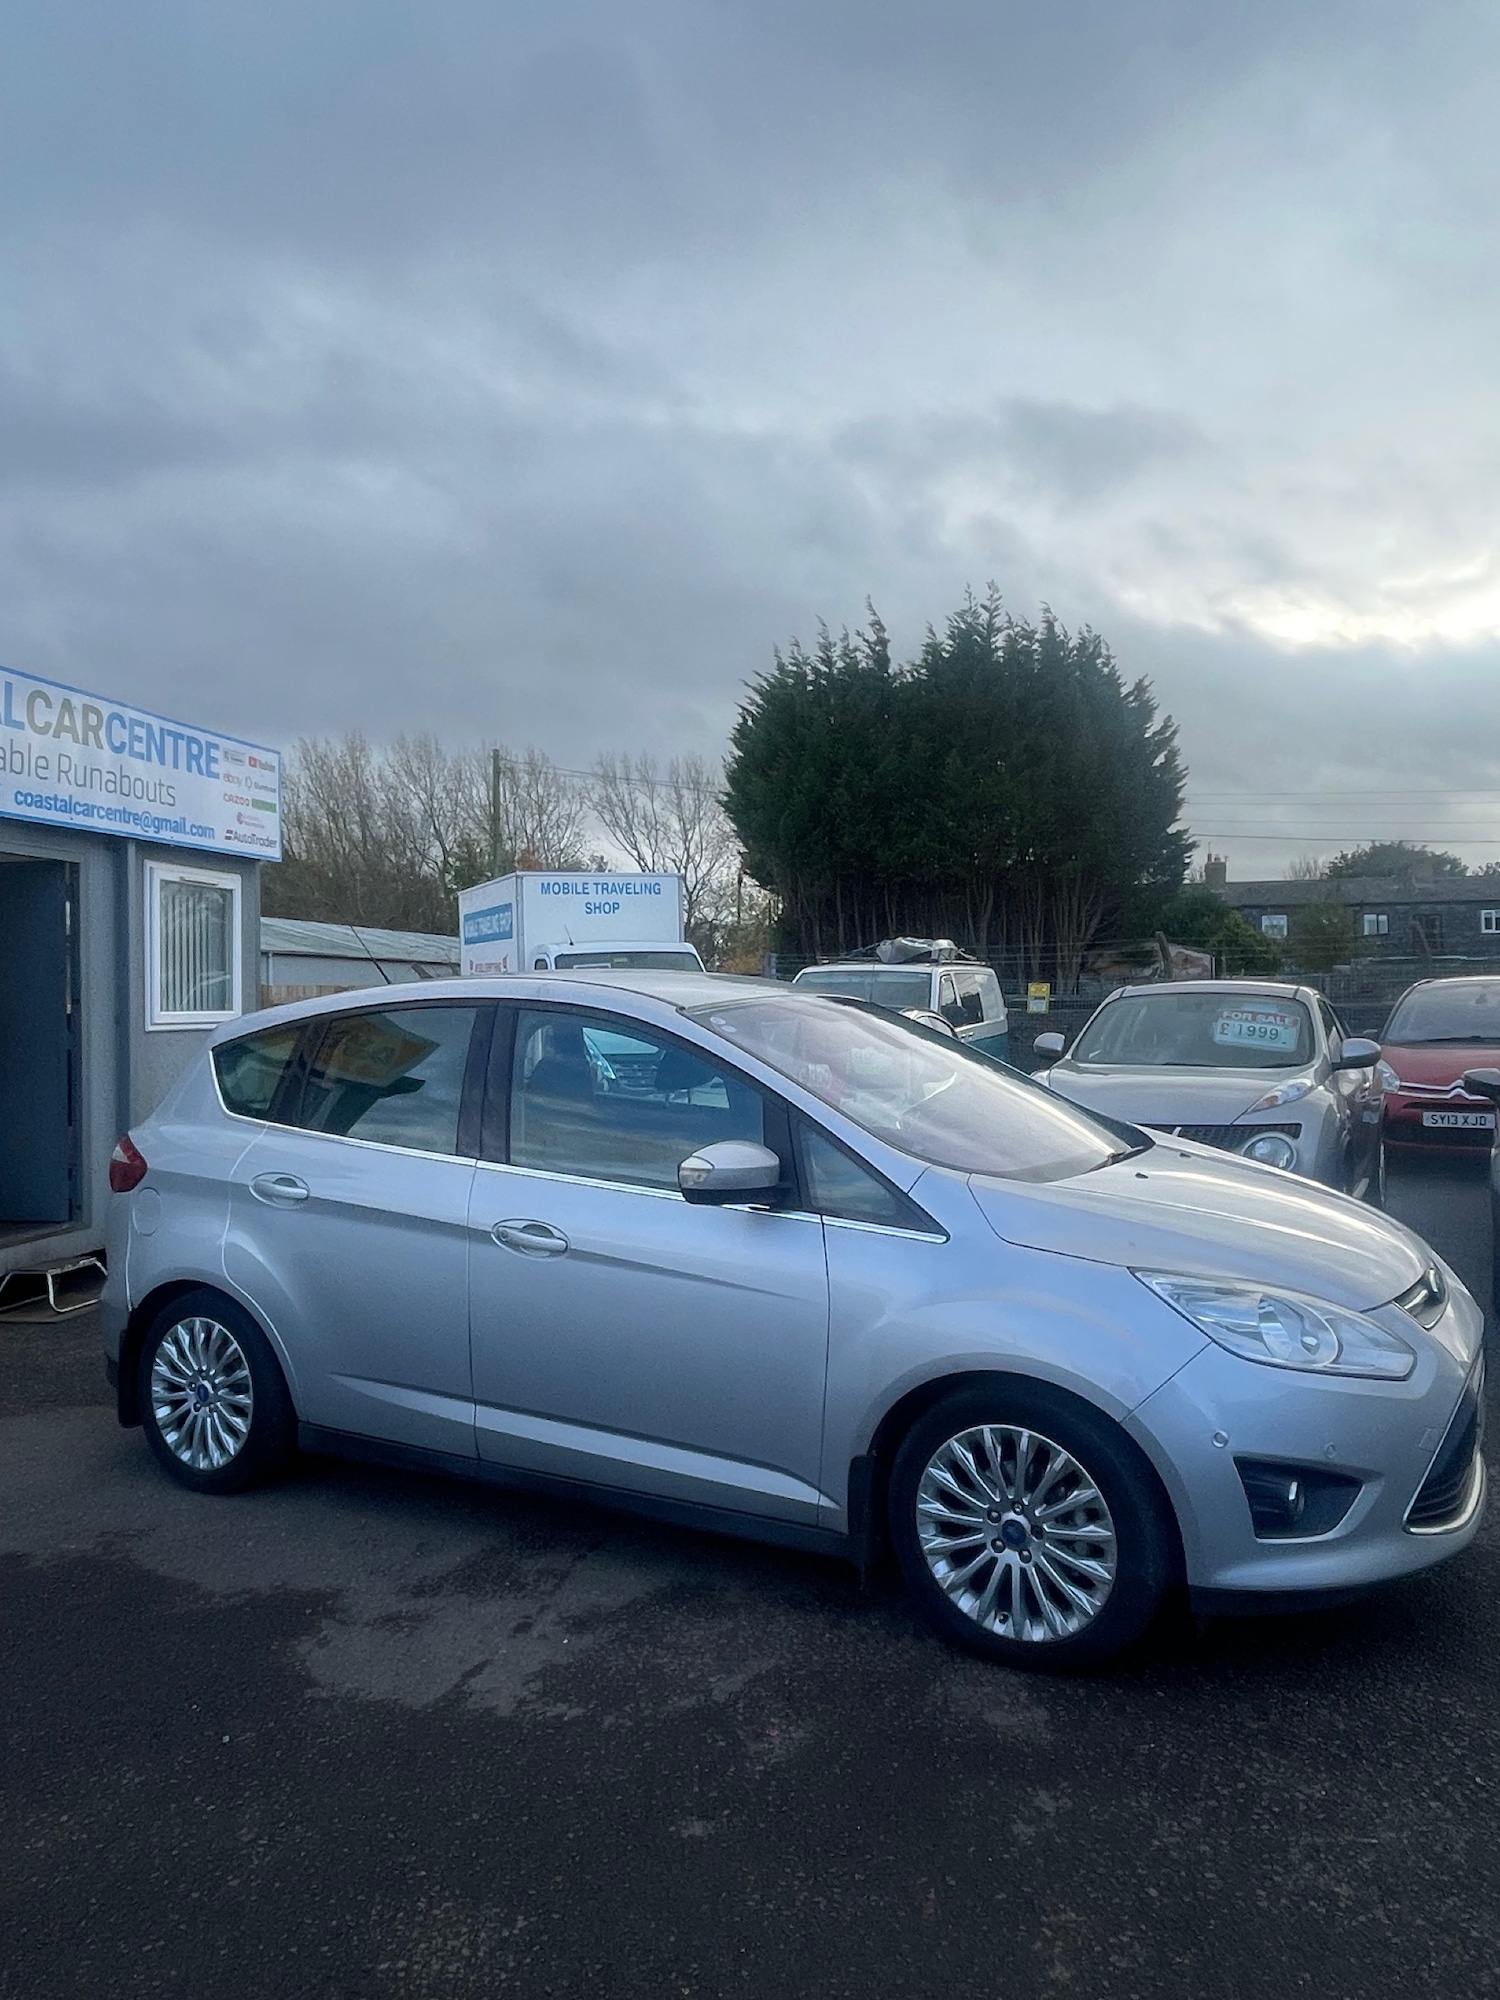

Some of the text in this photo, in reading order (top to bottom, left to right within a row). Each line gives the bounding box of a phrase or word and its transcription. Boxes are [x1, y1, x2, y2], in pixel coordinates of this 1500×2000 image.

[0, 680, 220, 780] LCARCENTRE
[57, 752, 176, 807] Runabouts
[14, 789, 215, 840] coastalcarcentre@gmail.com
[540, 882, 662, 896] MOBILE TRAVELING
[585, 902, 620, 915] SHOP
[1222, 1010, 1294, 1026] FOR SALE
[1430, 1114, 1487, 1126] SY13 XJD
